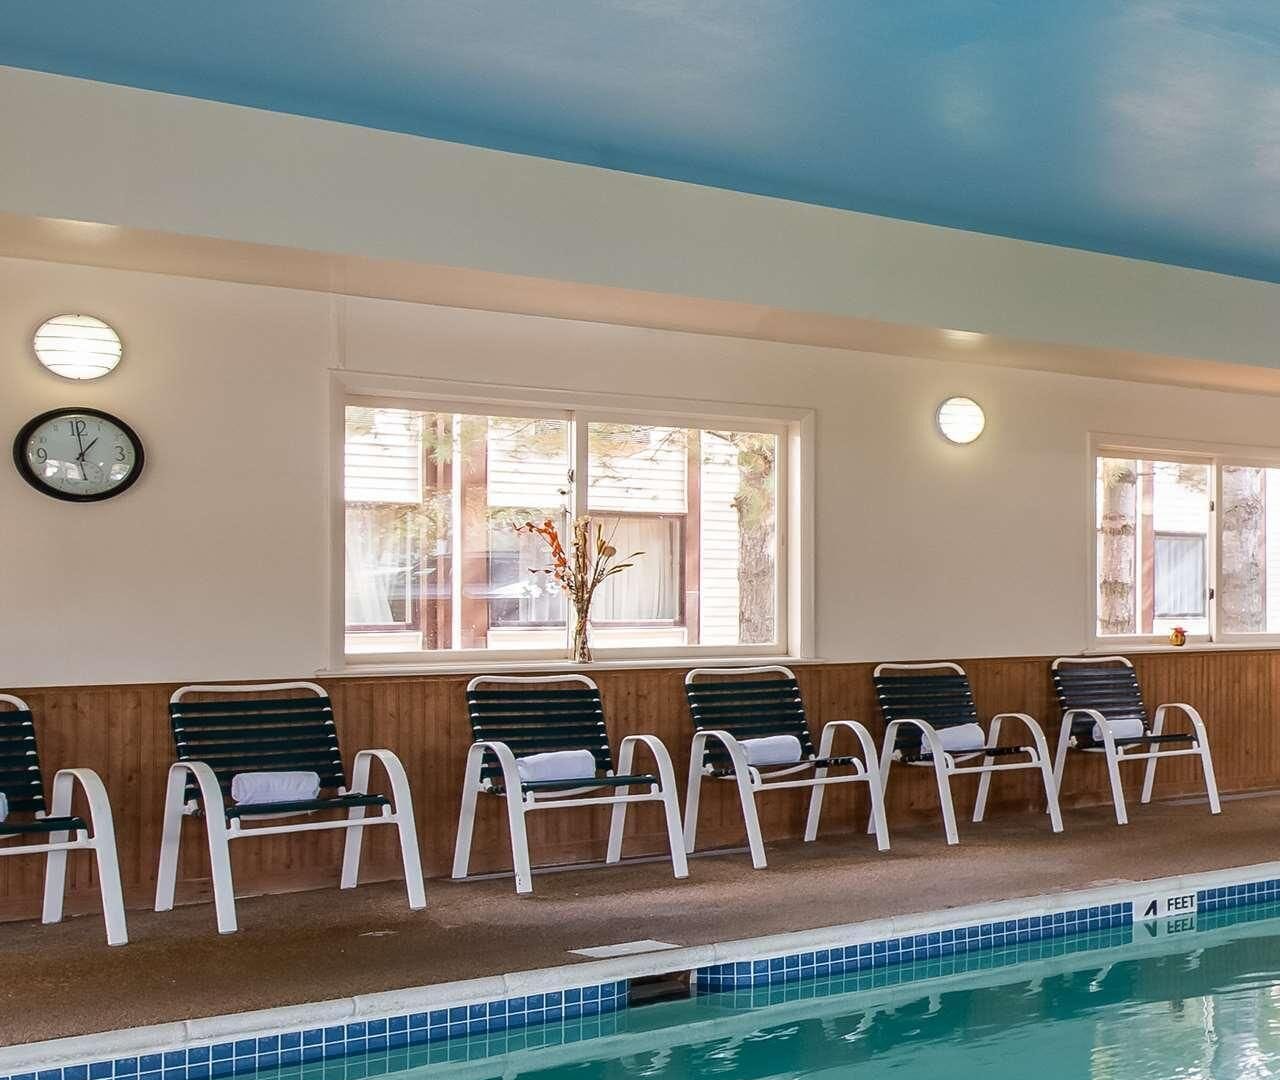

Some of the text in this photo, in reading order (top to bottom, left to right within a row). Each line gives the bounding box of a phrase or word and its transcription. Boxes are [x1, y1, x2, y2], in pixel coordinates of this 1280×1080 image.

[69, 420, 88, 437] 12
[37, 447, 48, 464] 9
[114, 445, 126, 461] 3
[1167, 895, 1195, 911] FEET
